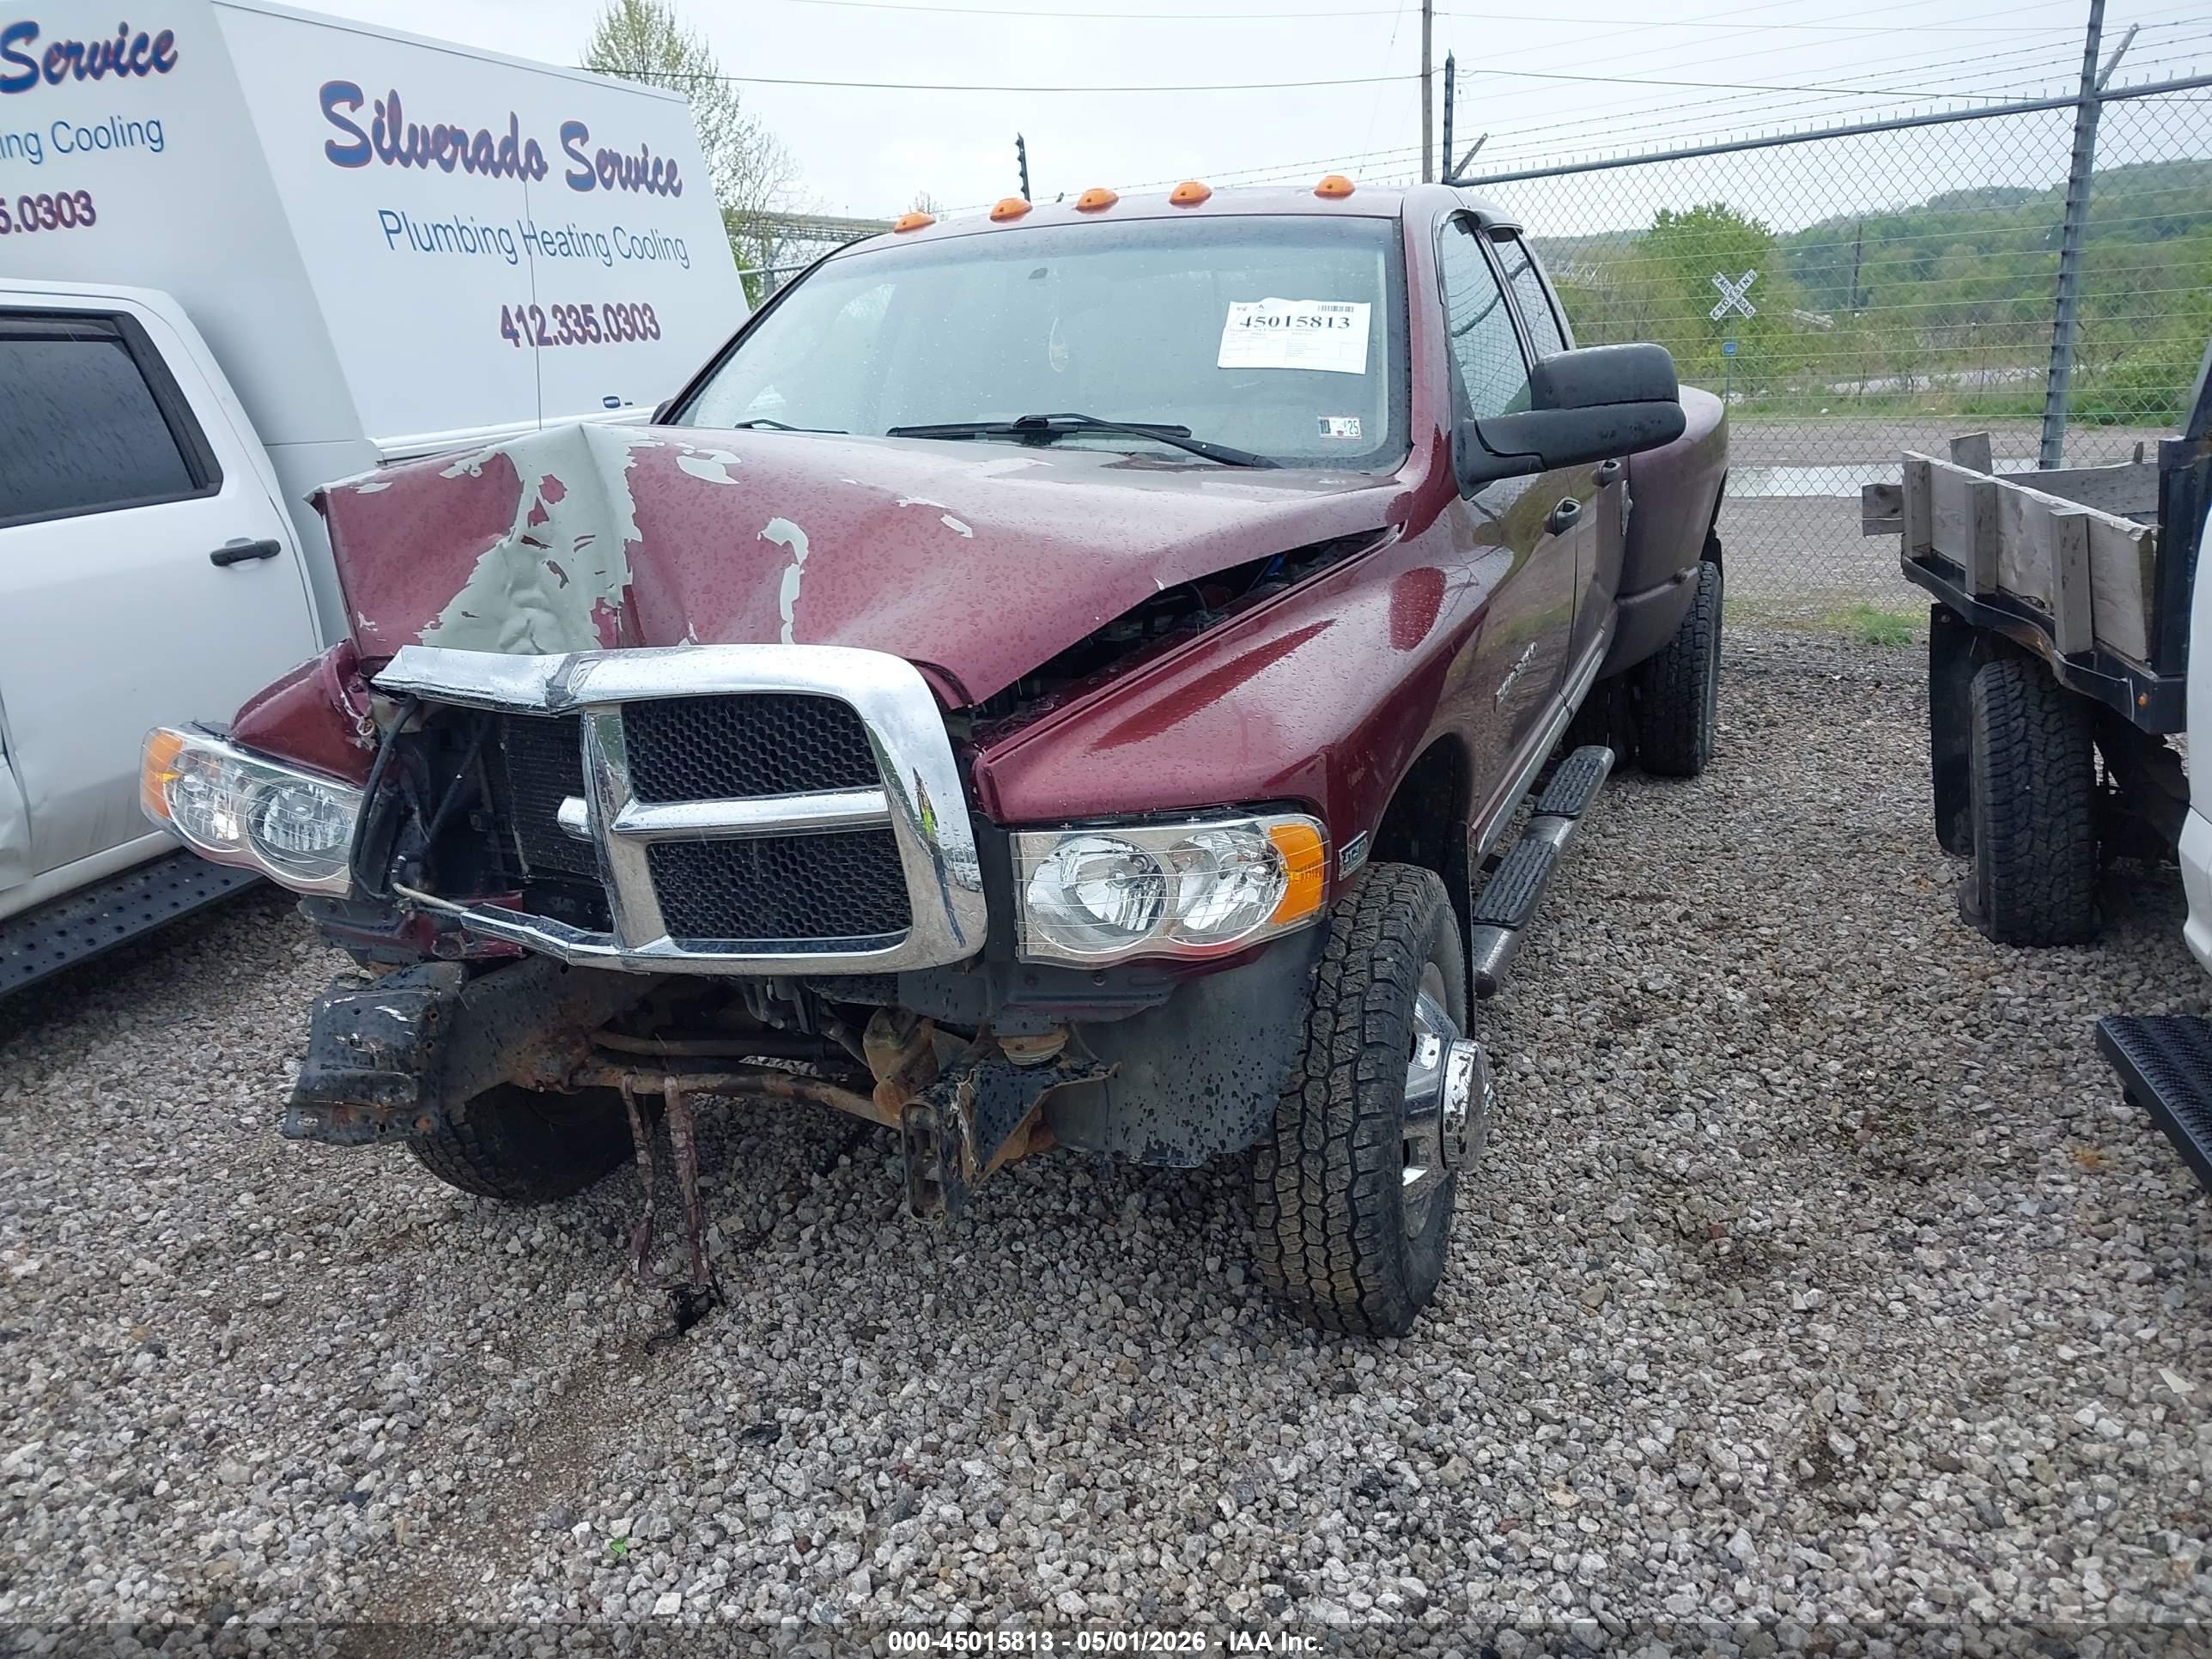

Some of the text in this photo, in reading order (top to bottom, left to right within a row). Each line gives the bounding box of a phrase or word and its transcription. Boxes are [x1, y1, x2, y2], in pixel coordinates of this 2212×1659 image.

[0, 21, 179, 94] Service
[0, 115, 164, 165] ing Cooling
[319, 80, 683, 198] Silverado Service
[378, 210, 690, 270] Plumbing Heating Cooling
[501, 302, 660, 347] 412.335.0303
[1240, 315, 1350, 330] 45015813
